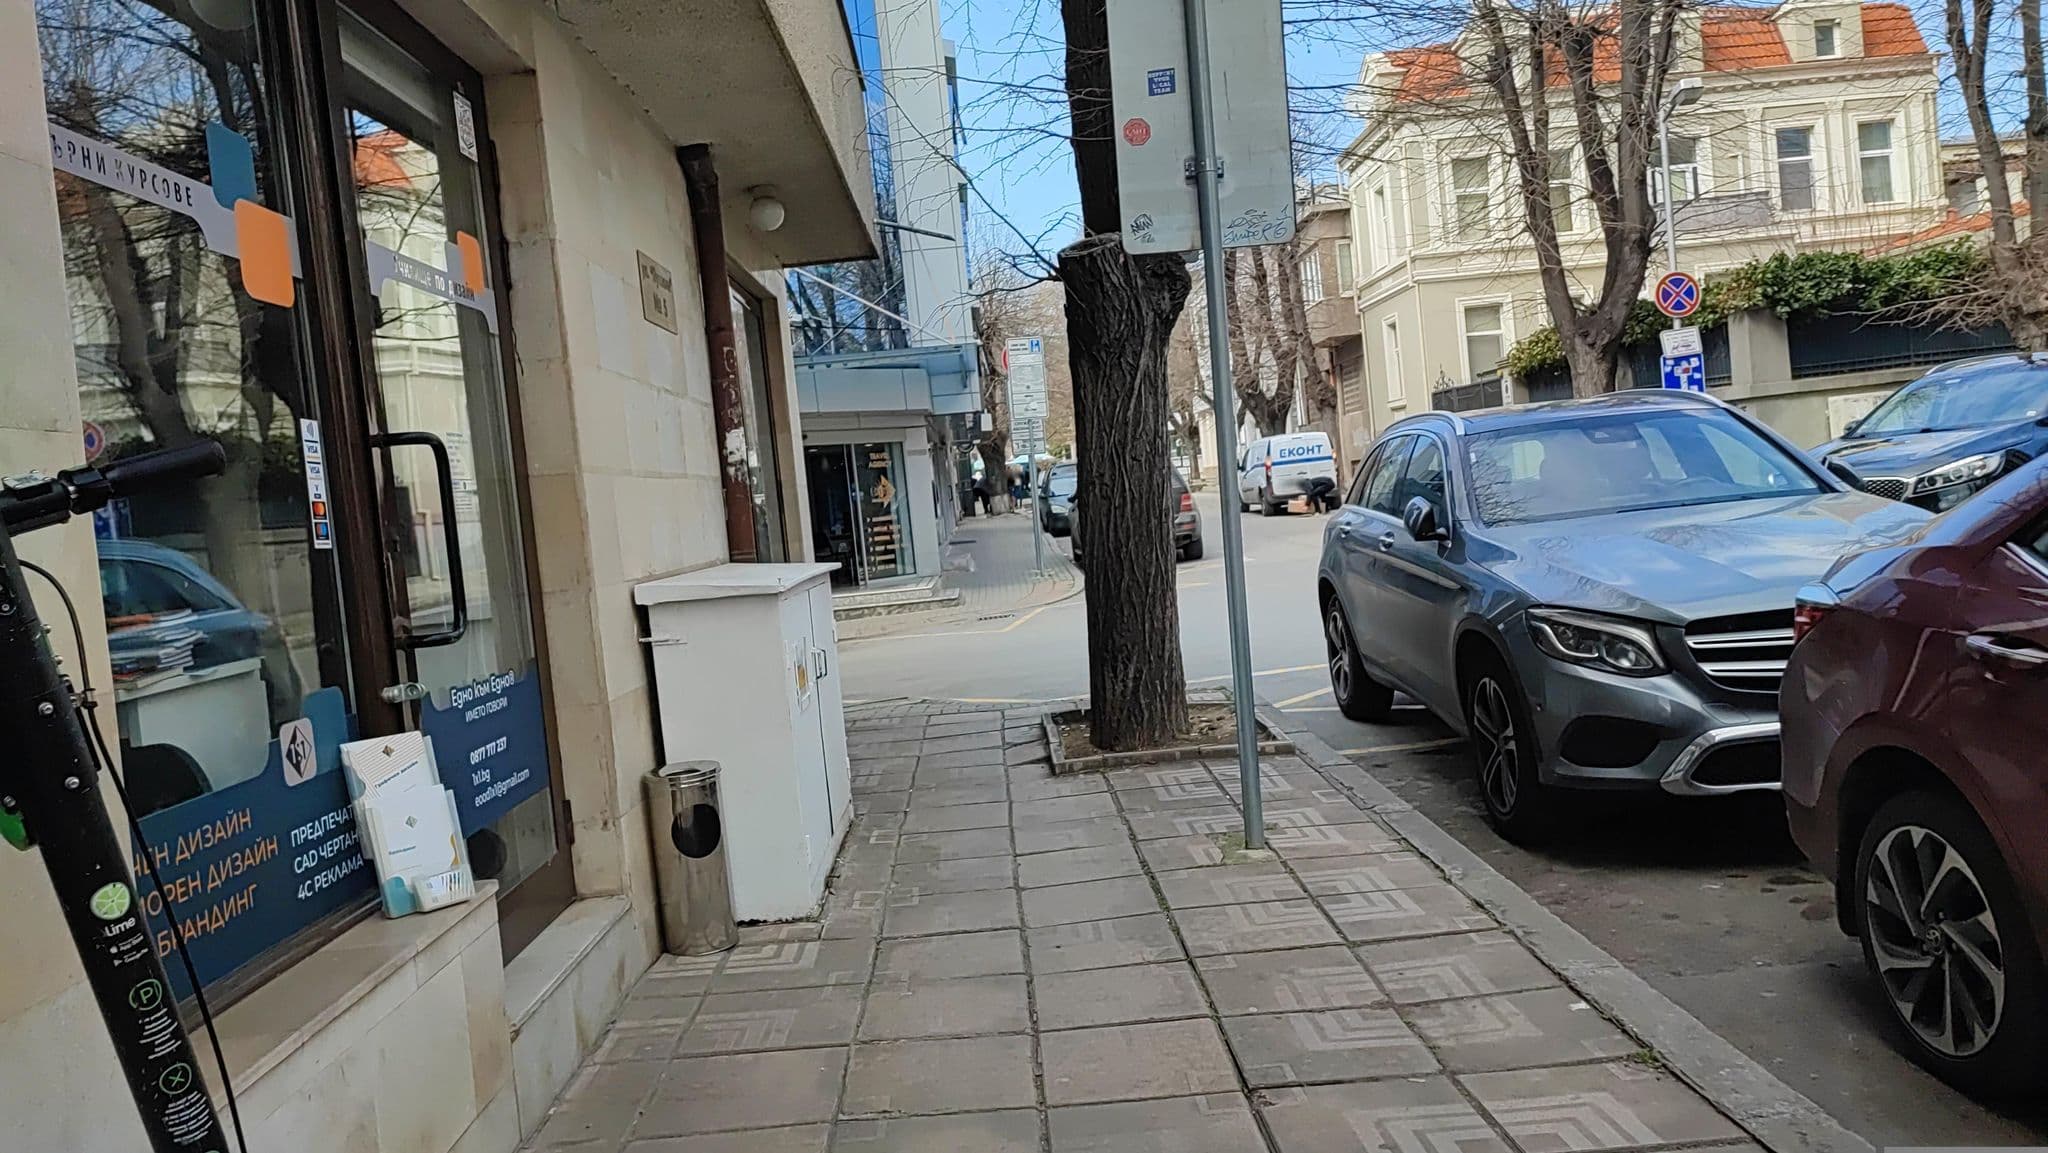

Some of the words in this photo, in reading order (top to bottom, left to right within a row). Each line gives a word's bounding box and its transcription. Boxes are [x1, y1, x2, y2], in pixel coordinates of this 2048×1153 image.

[115, 158, 193, 207] КУРСОВЕ
[307, 445, 318, 454] VISA
[1279, 444, 1323, 458] ЕКОНТ
[309, 465, 320, 474] VISA
[465, 704, 486, 722] ИМЕТО
[486, 696, 508, 713] ГОВОРИ
[470, 746, 486, 765] 0877
[175, 807, 252, 866] ДИЗАЙН
[207, 835, 279, 893] ДИЗАЙН
[294, 850, 318, 873] CAD
[314, 852, 364, 892] РЕКЛАМА
[105, 917, 136, 936] Lime
